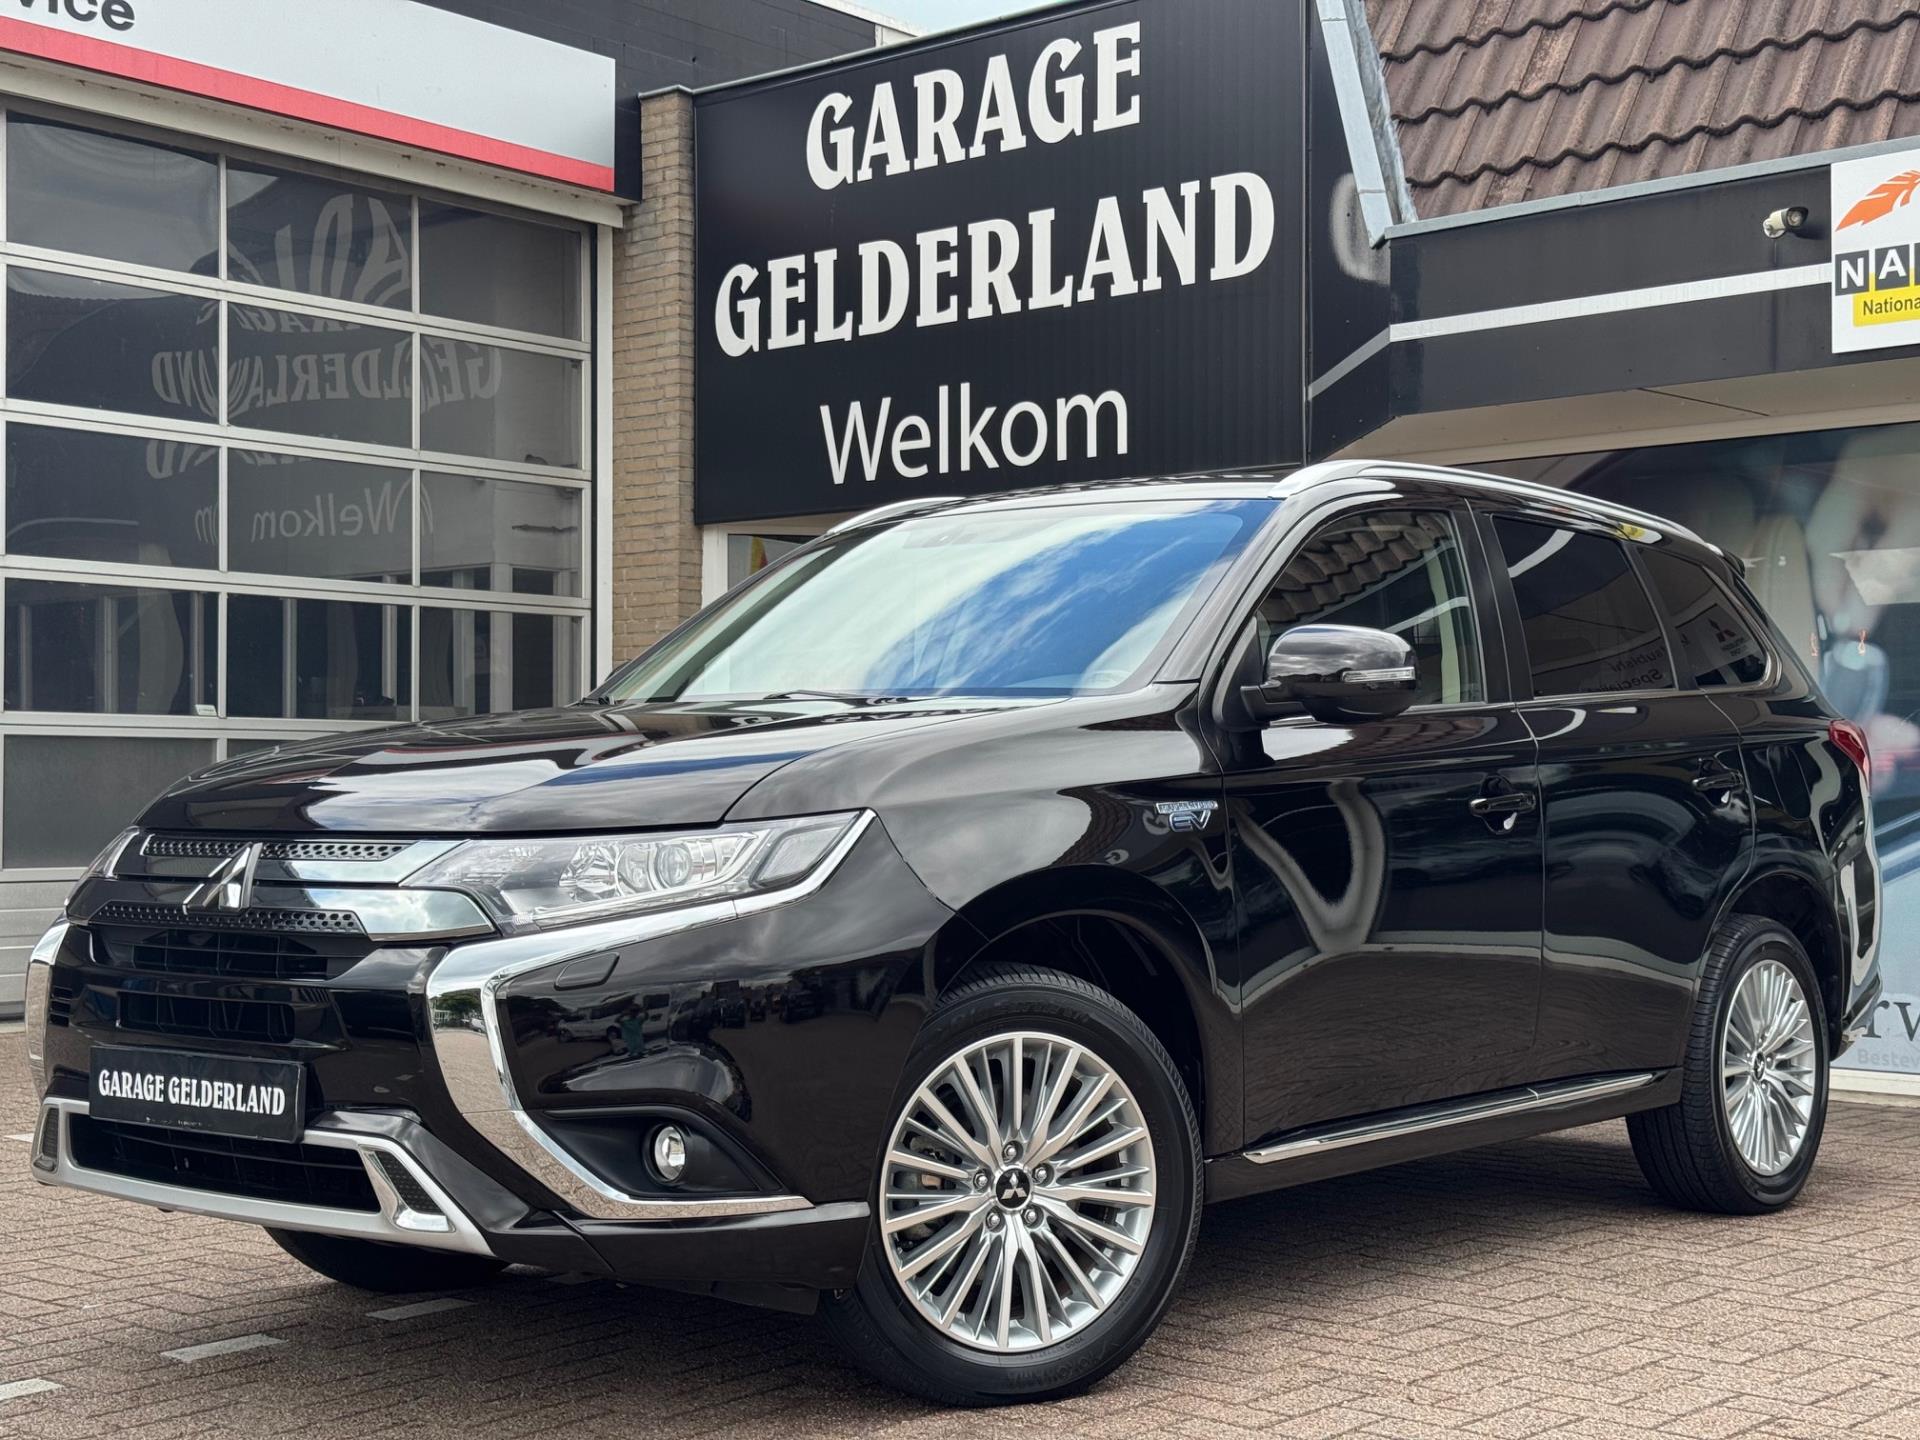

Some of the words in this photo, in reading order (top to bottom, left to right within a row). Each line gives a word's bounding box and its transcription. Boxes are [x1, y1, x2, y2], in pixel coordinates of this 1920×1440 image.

[20, 0, 135, 31] ce
[806, 21, 1141, 190] GARAGE
[715, 172, 1274, 356] GELDERLAND
[820, 383, 1128, 484] Welkom
[98, 1069, 164, 1103] GARAGE
[168, 1076, 286, 1116] GELDERLAND
